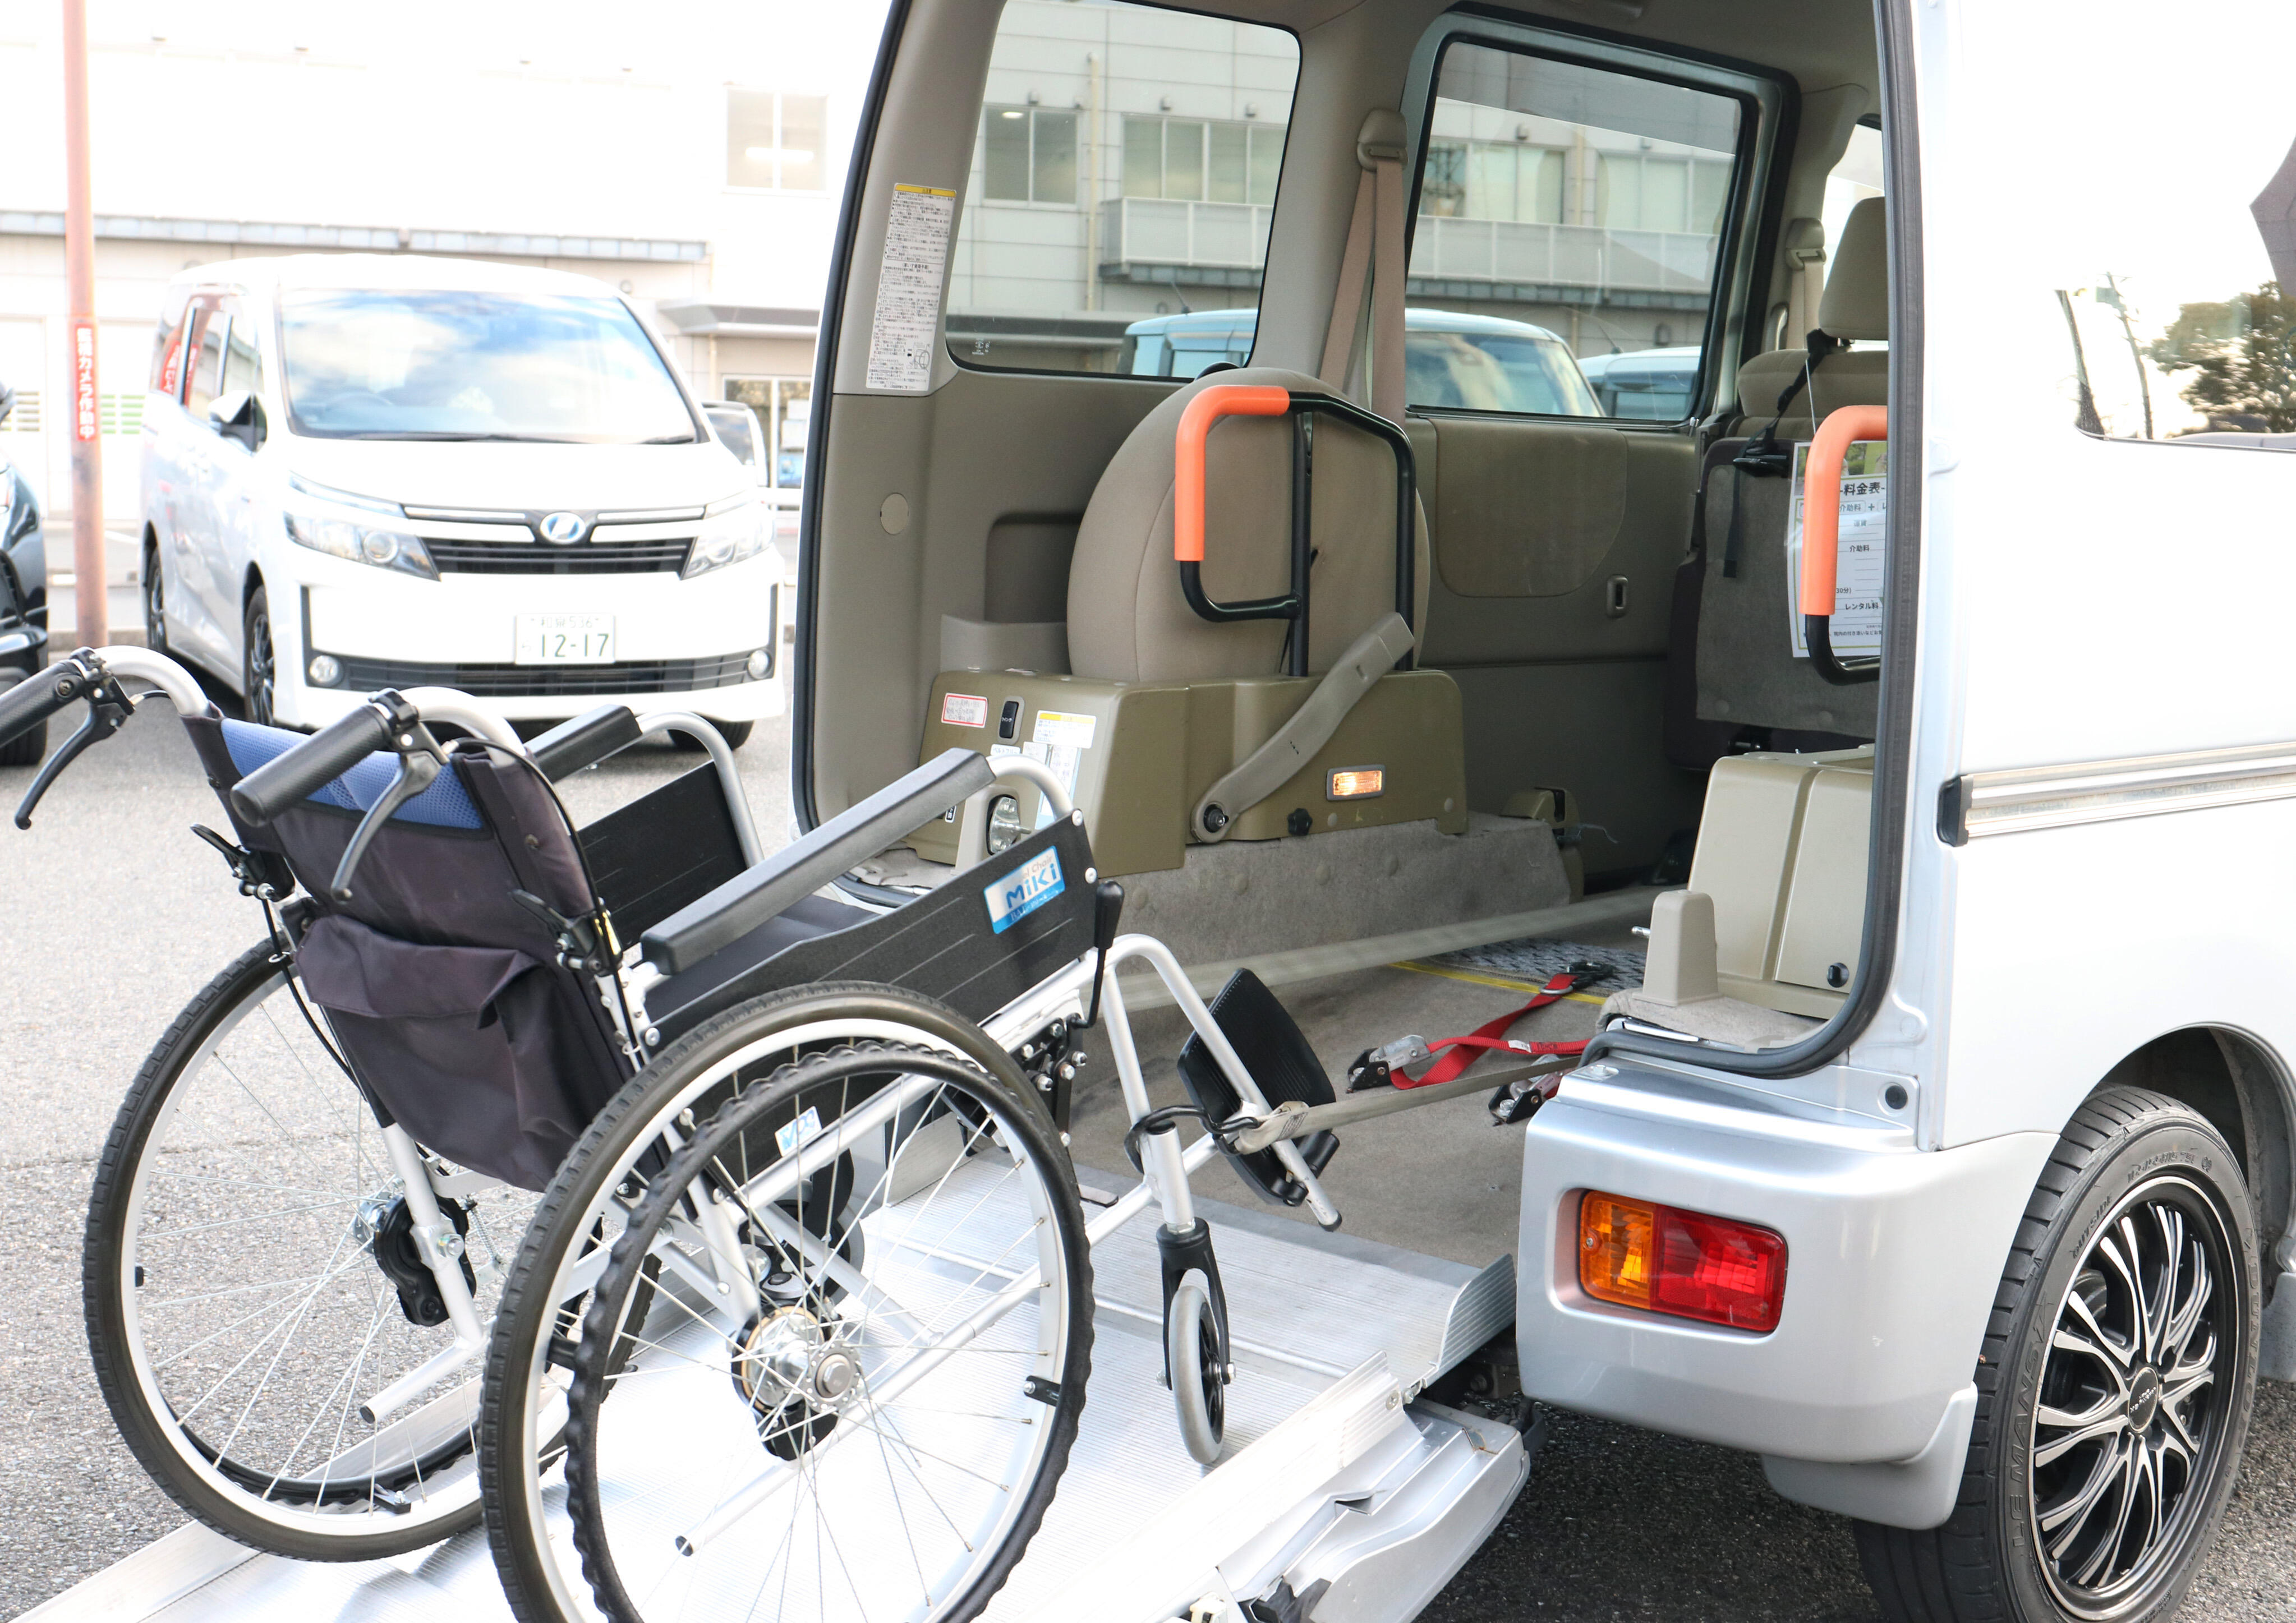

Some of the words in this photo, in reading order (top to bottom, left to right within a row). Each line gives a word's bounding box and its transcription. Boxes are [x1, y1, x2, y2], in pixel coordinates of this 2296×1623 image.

[1845, 602, 1879, 610] レンタル料
[541, 633, 609, 658] 12-17
[2010, 1347, 2040, 1484] MANS
[2009, 1492, 2026, 1549] LE
